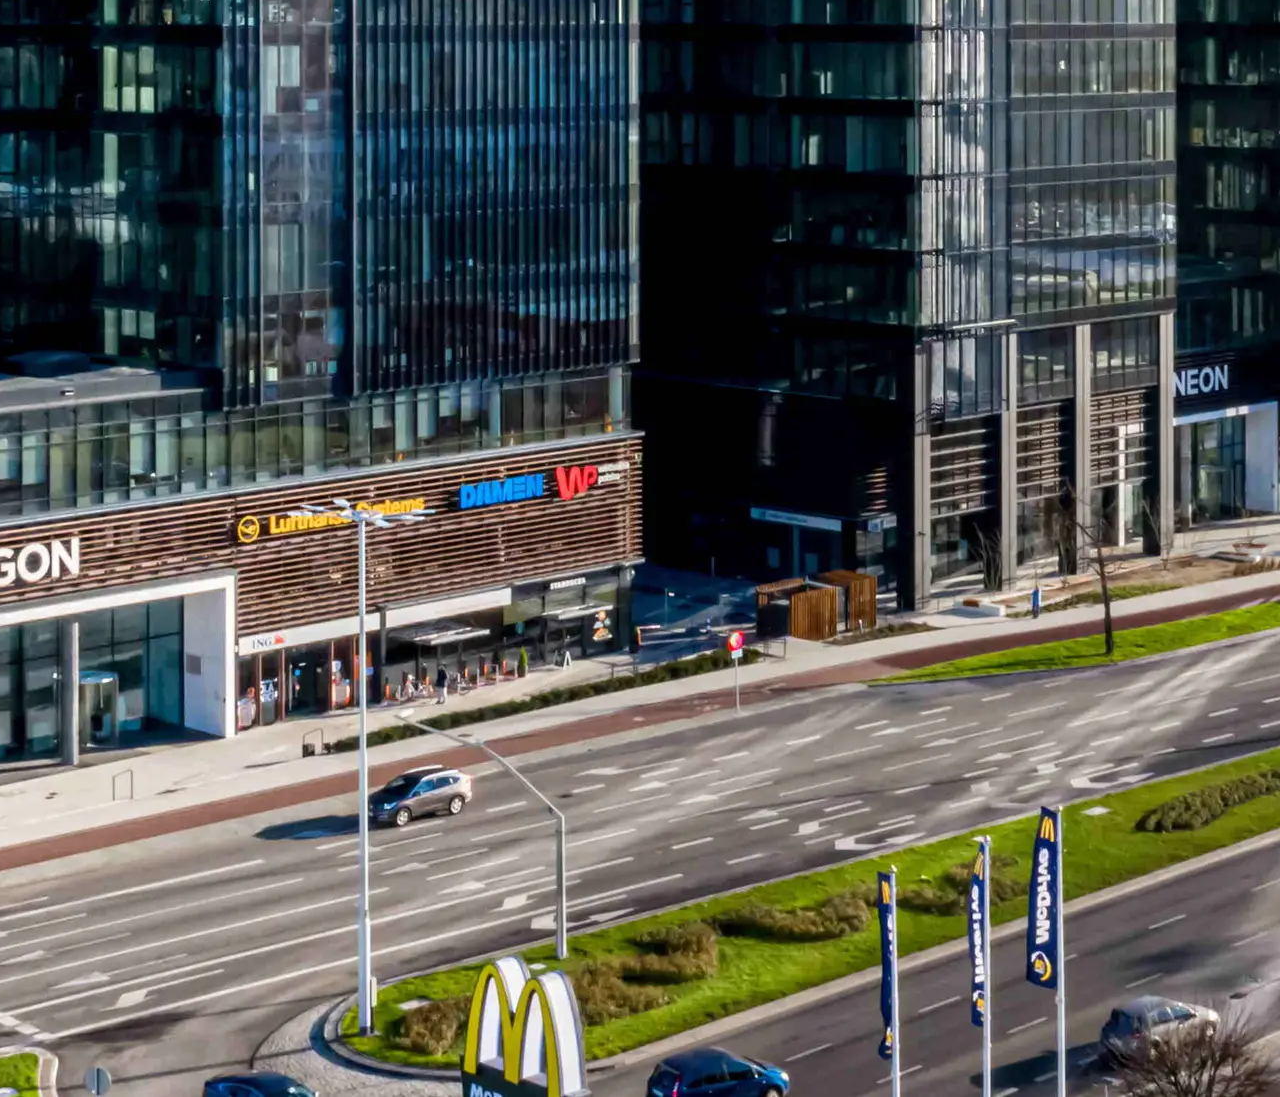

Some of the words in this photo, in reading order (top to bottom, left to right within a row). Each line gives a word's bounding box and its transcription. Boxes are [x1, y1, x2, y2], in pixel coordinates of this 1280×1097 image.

[1171, 364, 1228, 398] NEON
[460, 473, 545, 510] DAMEN
[556, 464, 599, 501] WP
[252, 637, 272, 650] ING
[1035, 847, 1052, 945] McDrive
